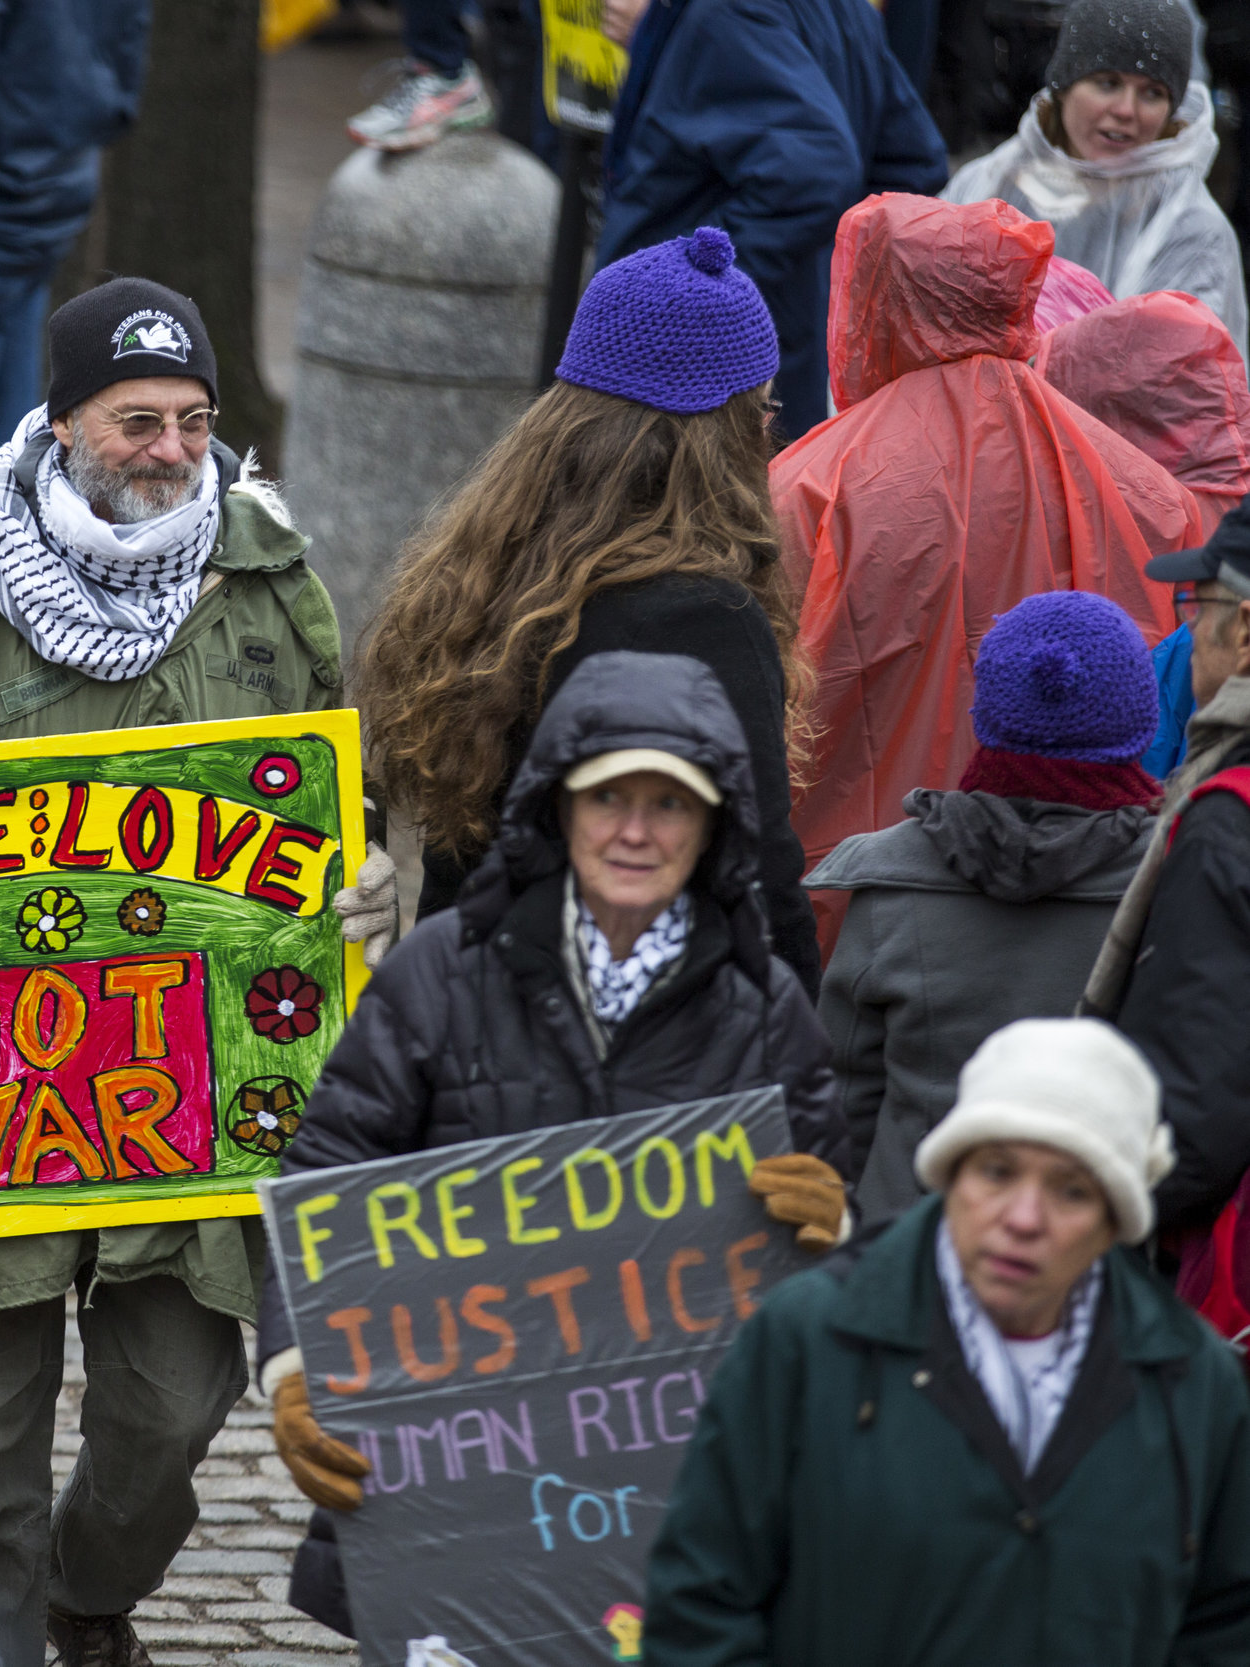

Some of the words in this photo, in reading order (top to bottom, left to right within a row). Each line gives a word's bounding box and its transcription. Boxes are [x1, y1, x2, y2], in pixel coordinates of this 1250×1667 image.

[110, 309, 153, 343] VETERANS
[155, 310, 174, 323] FOR
[174, 322, 192, 350] PEACE
[295, 1122, 756, 1282] FREEDOM
[325, 1232, 769, 1394] JUSTICE
[532, 1474, 639, 1551] for
